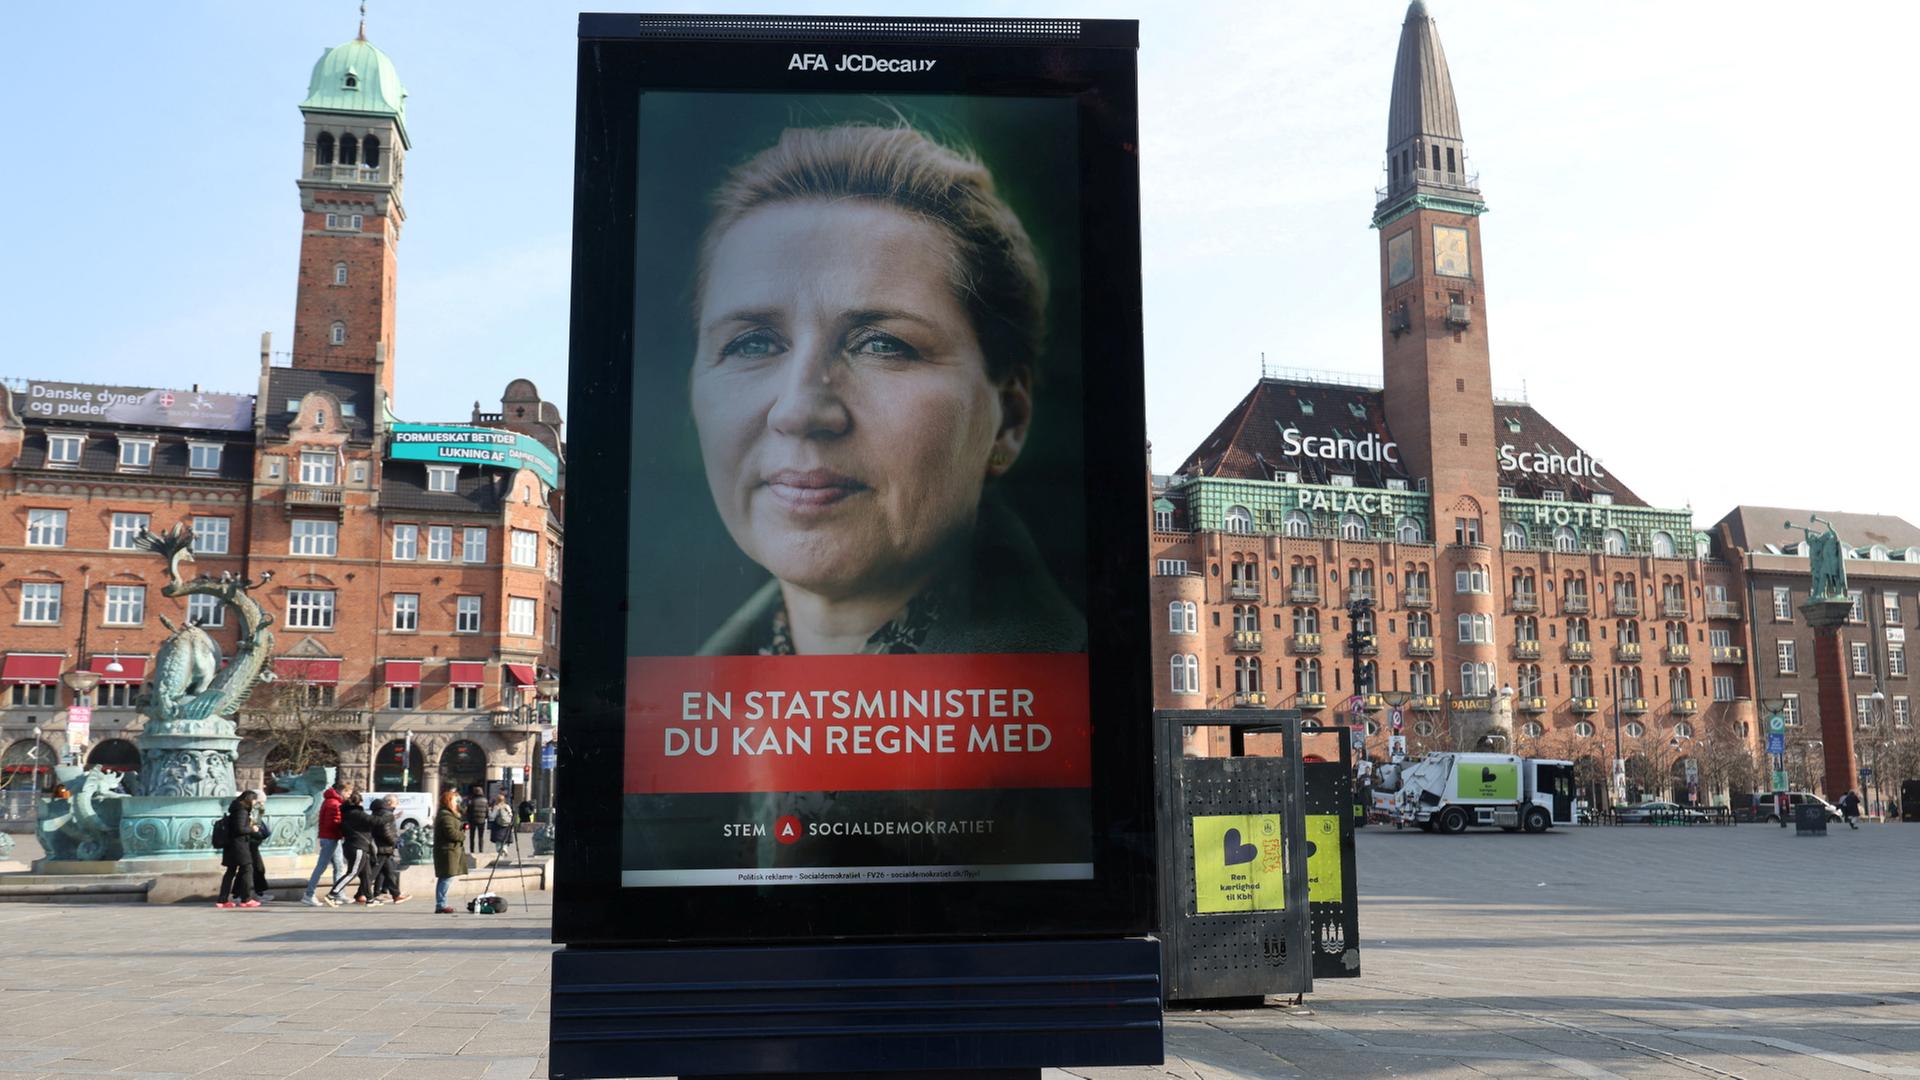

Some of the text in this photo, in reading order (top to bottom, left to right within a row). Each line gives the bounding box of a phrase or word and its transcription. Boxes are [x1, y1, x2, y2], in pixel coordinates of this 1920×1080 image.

[787, 53, 829, 71] AFA
[31, 385, 144, 406] Danske dyner
[31, 401, 108, 416] og puder
[396, 432, 515, 445] FORMUESKAT BETYDER
[1282, 428, 1398, 463] Scandic
[439, 447, 505, 461] LUKNING AF
[1500, 443, 1605, 478] Scandic
[1299, 489, 1393, 515] PALACE
[1534, 505, 1618, 529] HOTEL
[682, 689, 1034, 721] EN STATSMINISTER
[664, 723, 1053, 757] DU KAN REGNE MED
[723, 823, 767, 837] STEM
[809, 820, 995, 836] SOCIALDEMOKRATIET
[738, 873, 764, 881] Politisk
[765, 873, 793, 881] reklame
[799, 872, 861, 880] Socialdemokratiet
[1220, 883, 1260, 892] kærlighed
